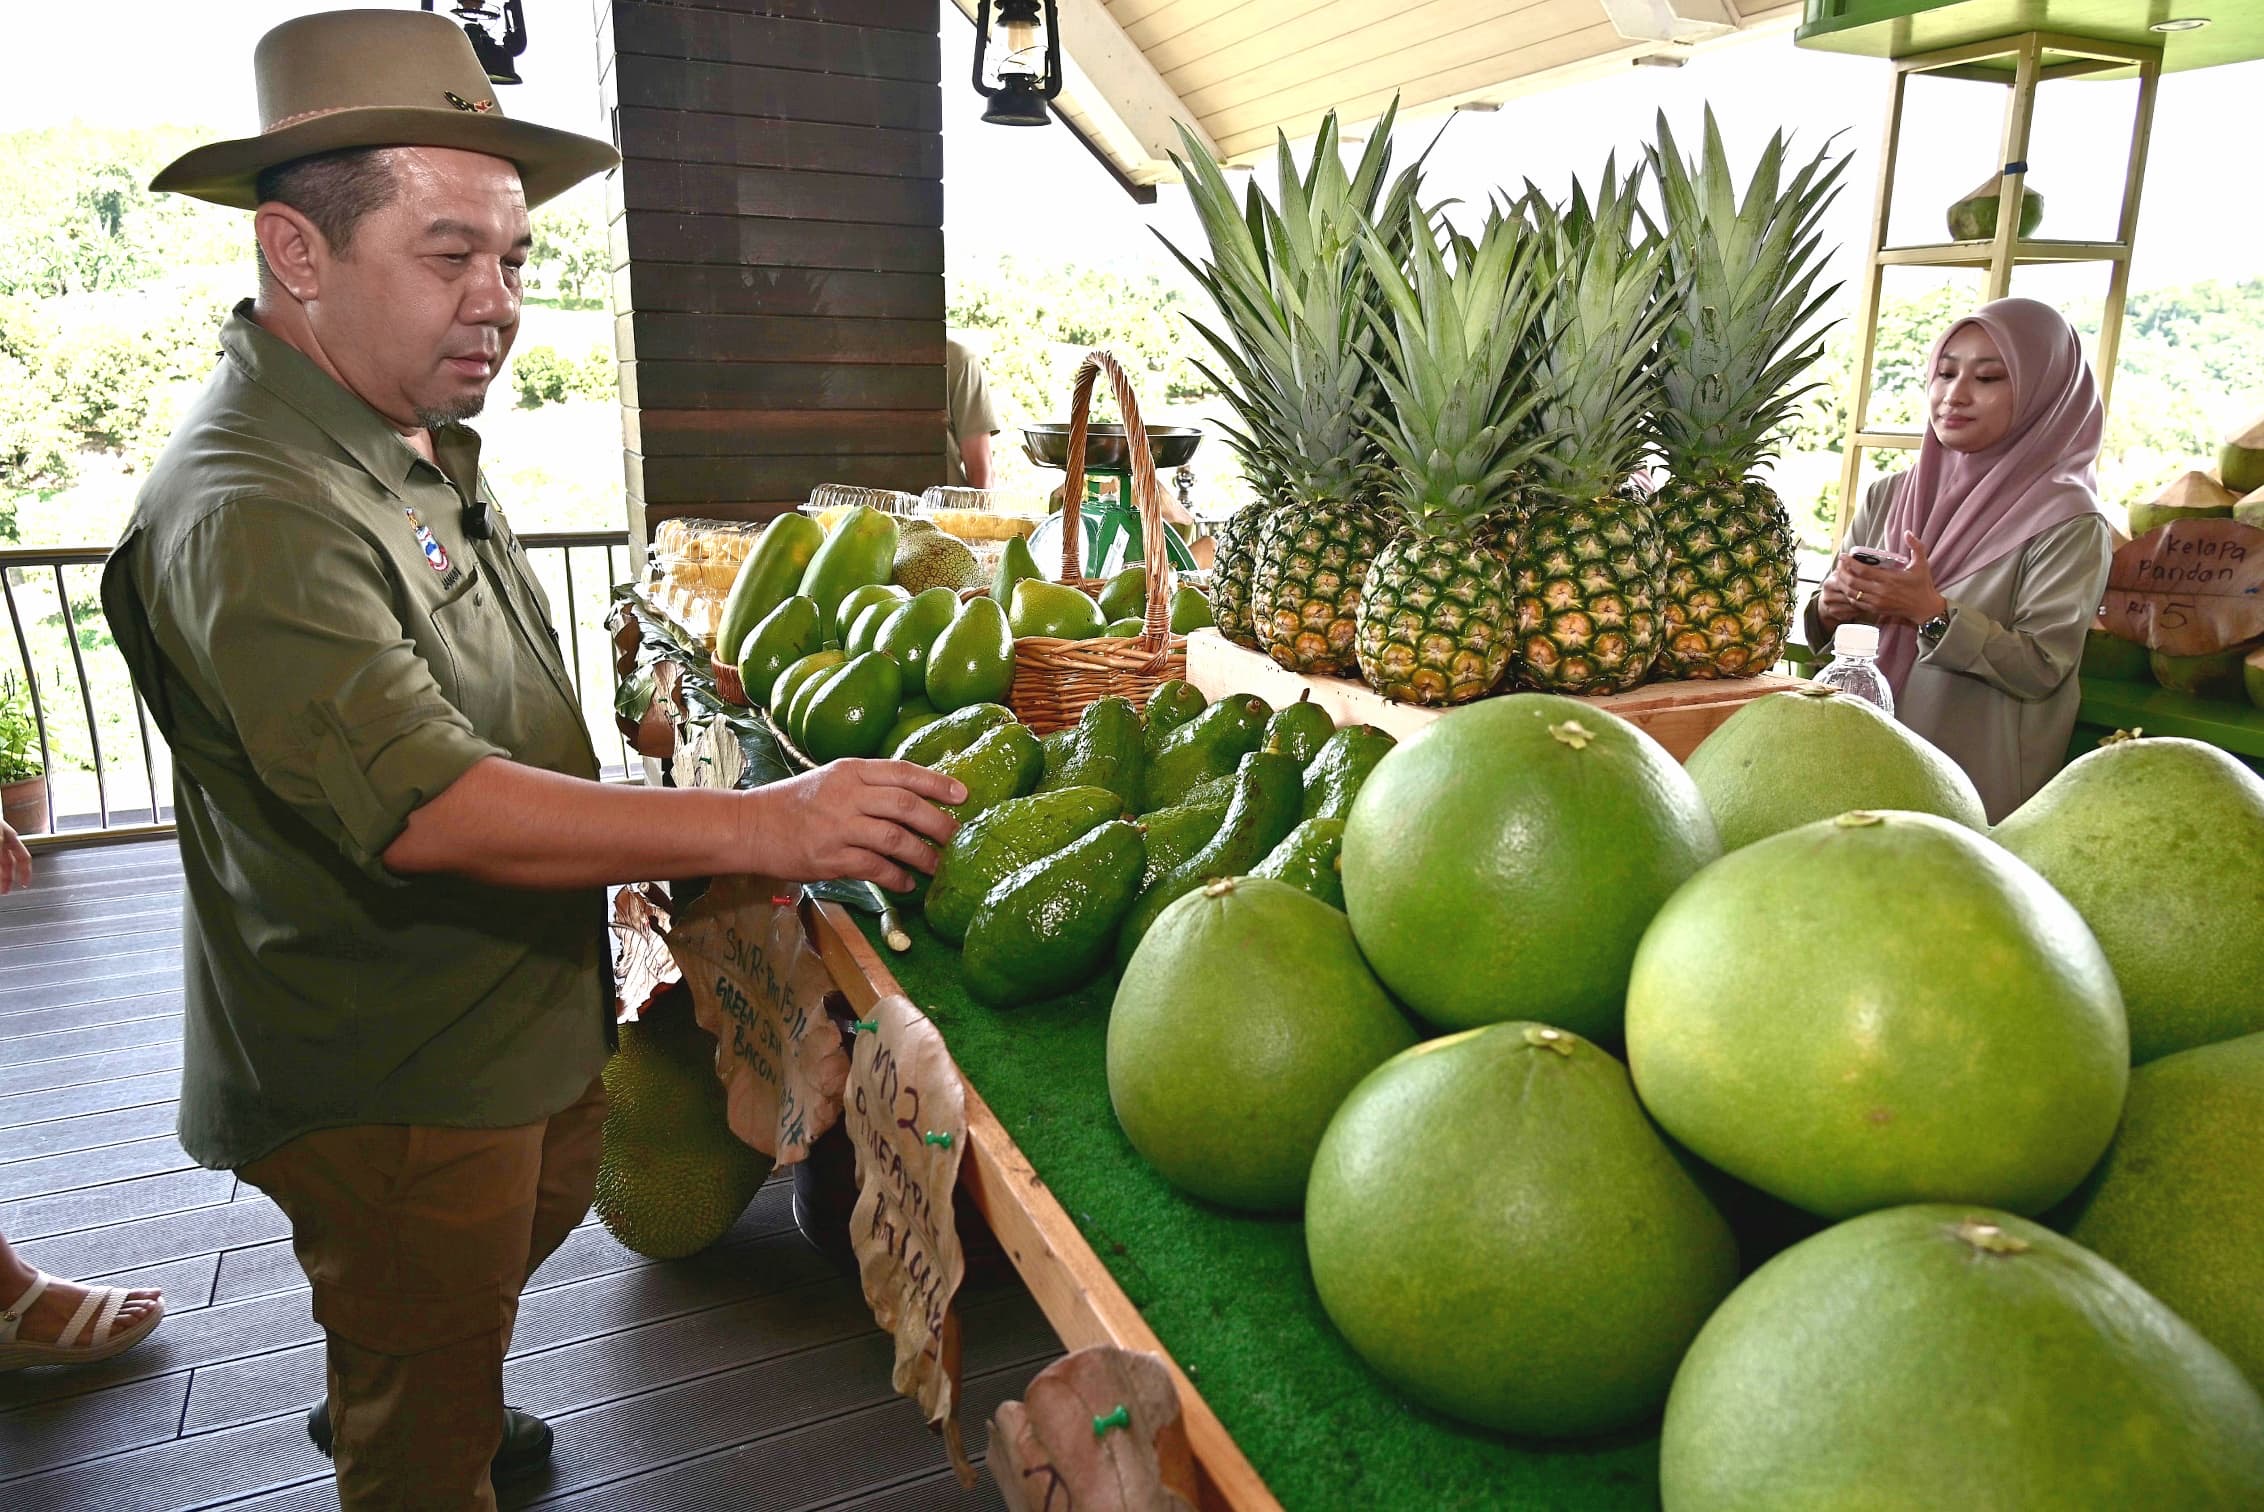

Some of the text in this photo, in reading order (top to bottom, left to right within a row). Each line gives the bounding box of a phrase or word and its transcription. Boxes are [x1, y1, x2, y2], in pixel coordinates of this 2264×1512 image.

[2138, 558, 2234, 582] Pandan
[2160, 602, 2196, 630] 5
[734, 1024, 777, 1086] BACON
